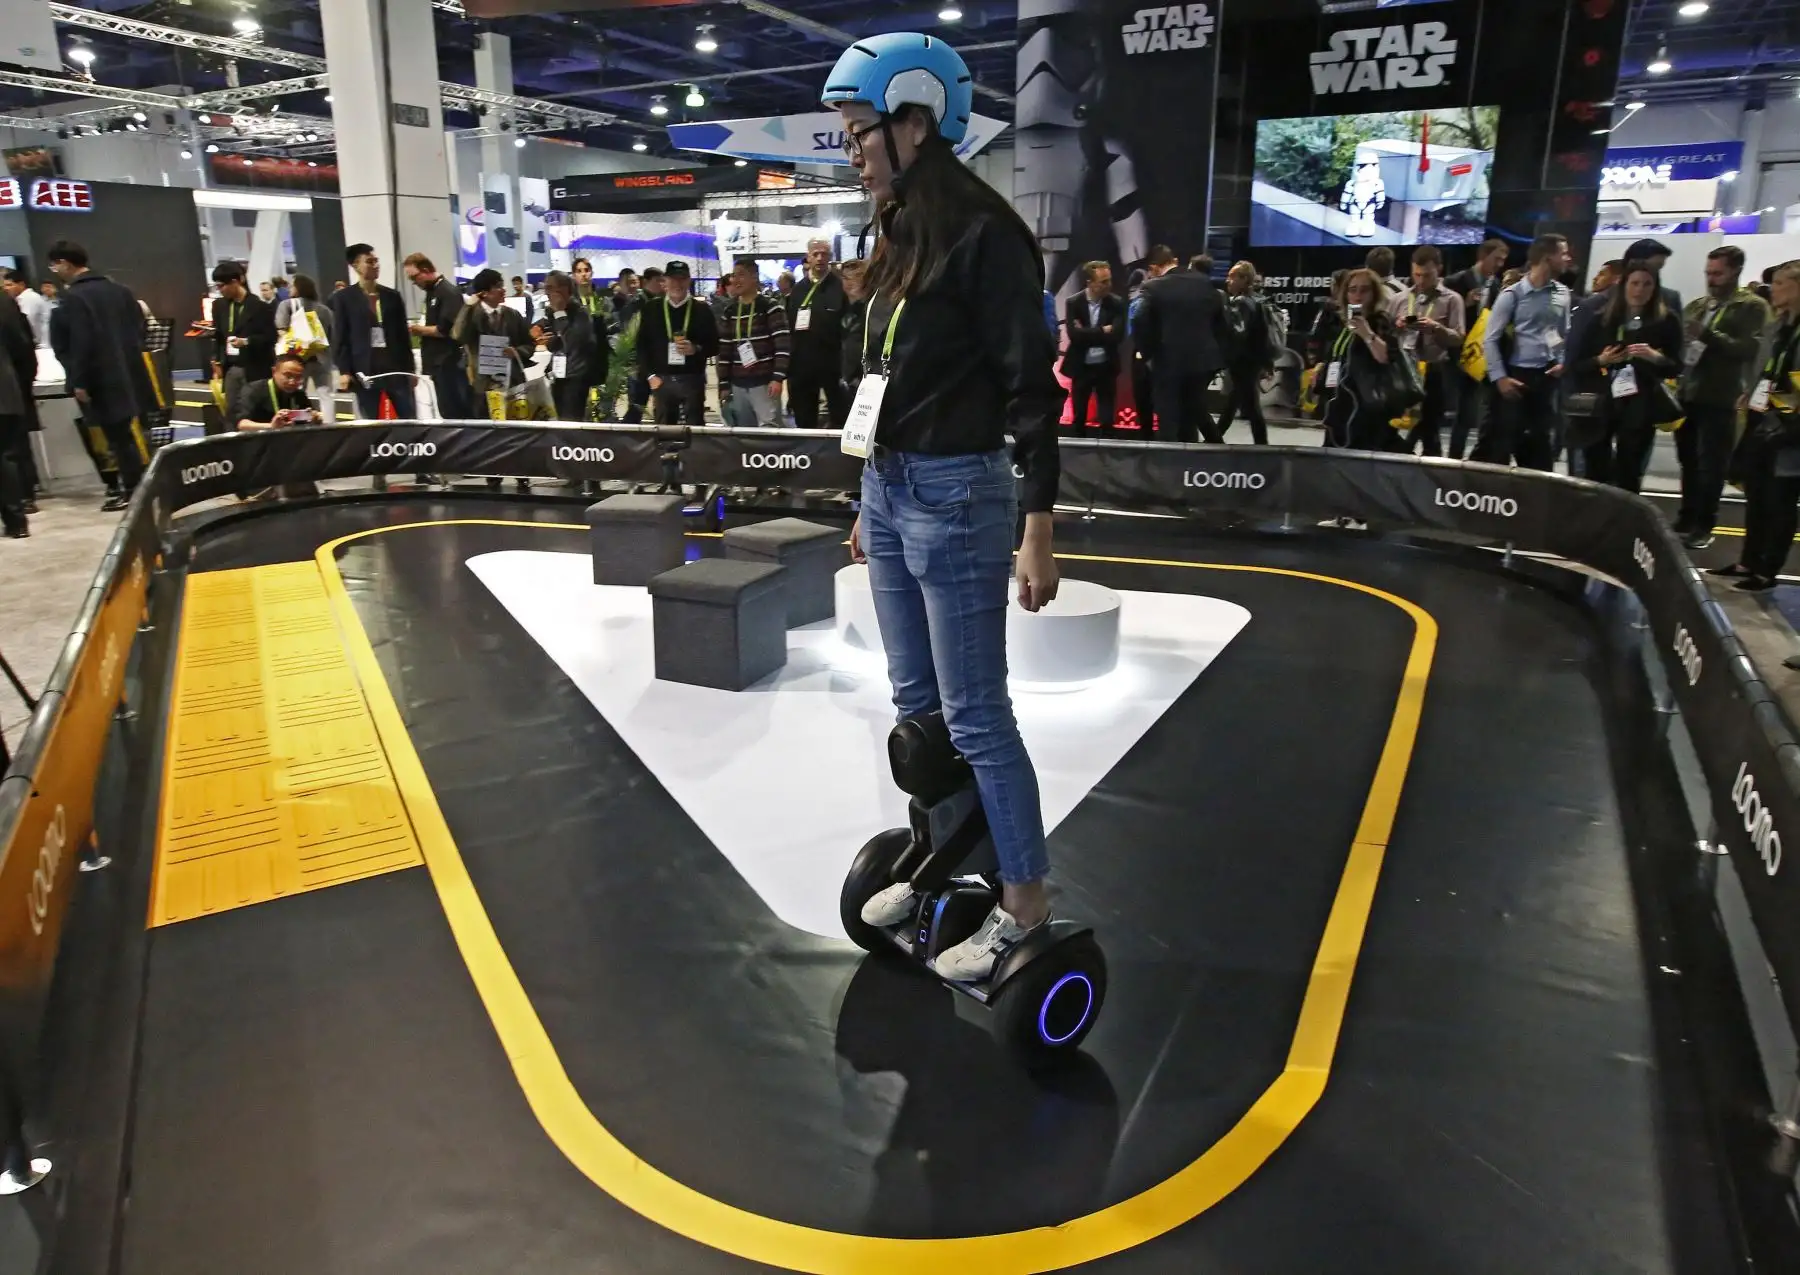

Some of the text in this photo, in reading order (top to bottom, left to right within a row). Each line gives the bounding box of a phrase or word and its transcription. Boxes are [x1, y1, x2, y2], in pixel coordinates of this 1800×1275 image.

[1121, 3, 1215, 34] STAR
[1121, 25, 1214, 55] WARS
[1309, 21, 1458, 64] STAR
[1309, 53, 1457, 95] WARS
[1662, 154, 1727, 165] GREAT
[614, 173, 695, 188] WINGSLAND
[36, 181, 92, 208] AEE
[1264, 276, 1333, 288] RST ORDE
[1274, 292, 1310, 304] OBOT
[371, 442, 437, 458] LOOMO
[551, 446, 615, 463] LOOMO
[741, 452, 812, 470] LOOMO
[180, 459, 235, 485] LOOMO
[1183, 470, 1266, 490] LOOMO
[1434, 487, 1518, 518] LOOMO
[1731, 761, 1782, 876] LOOMO
